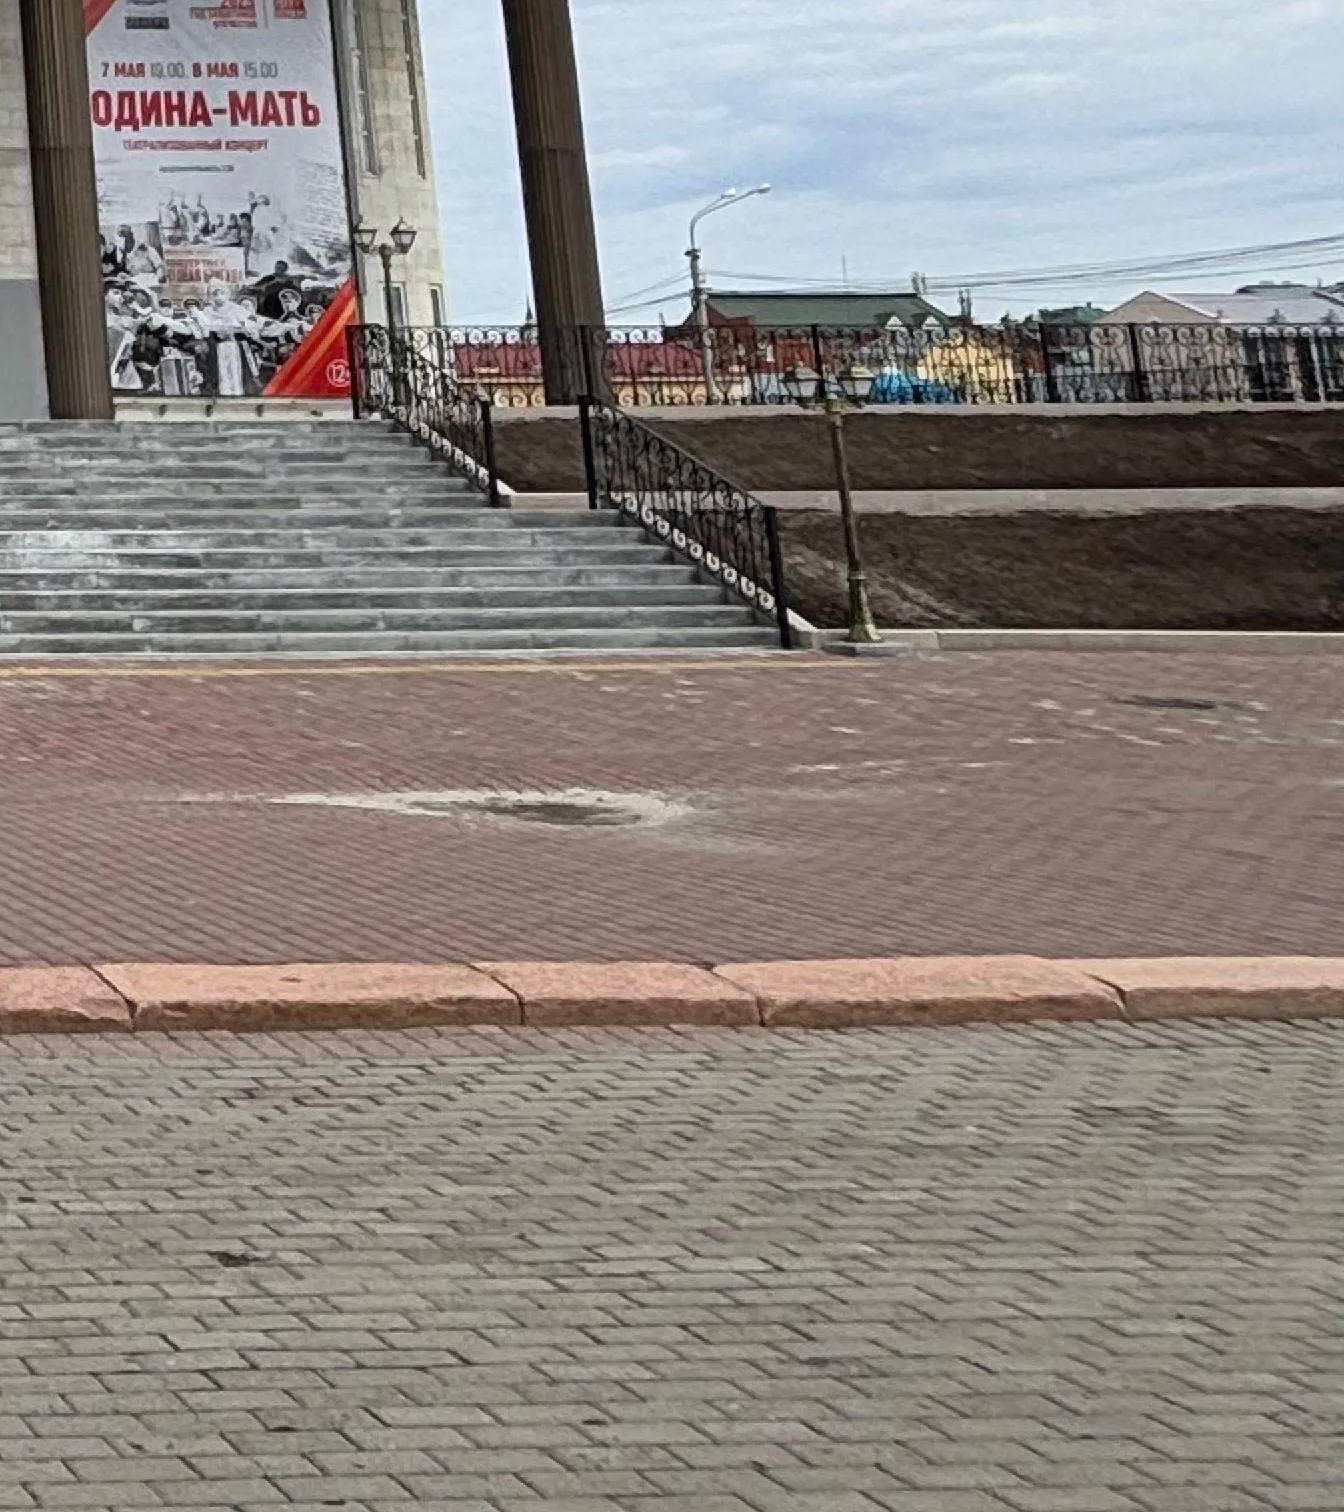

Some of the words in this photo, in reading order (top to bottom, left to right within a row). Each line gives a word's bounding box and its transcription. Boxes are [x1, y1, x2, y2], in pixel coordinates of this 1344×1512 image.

[101, 62, 110, 78] 7
[114, 62, 146, 78] МАЯ
[206, 62, 240, 78] МАЯ
[91, 89, 321, 132] ОДИНА-МАТЬ
